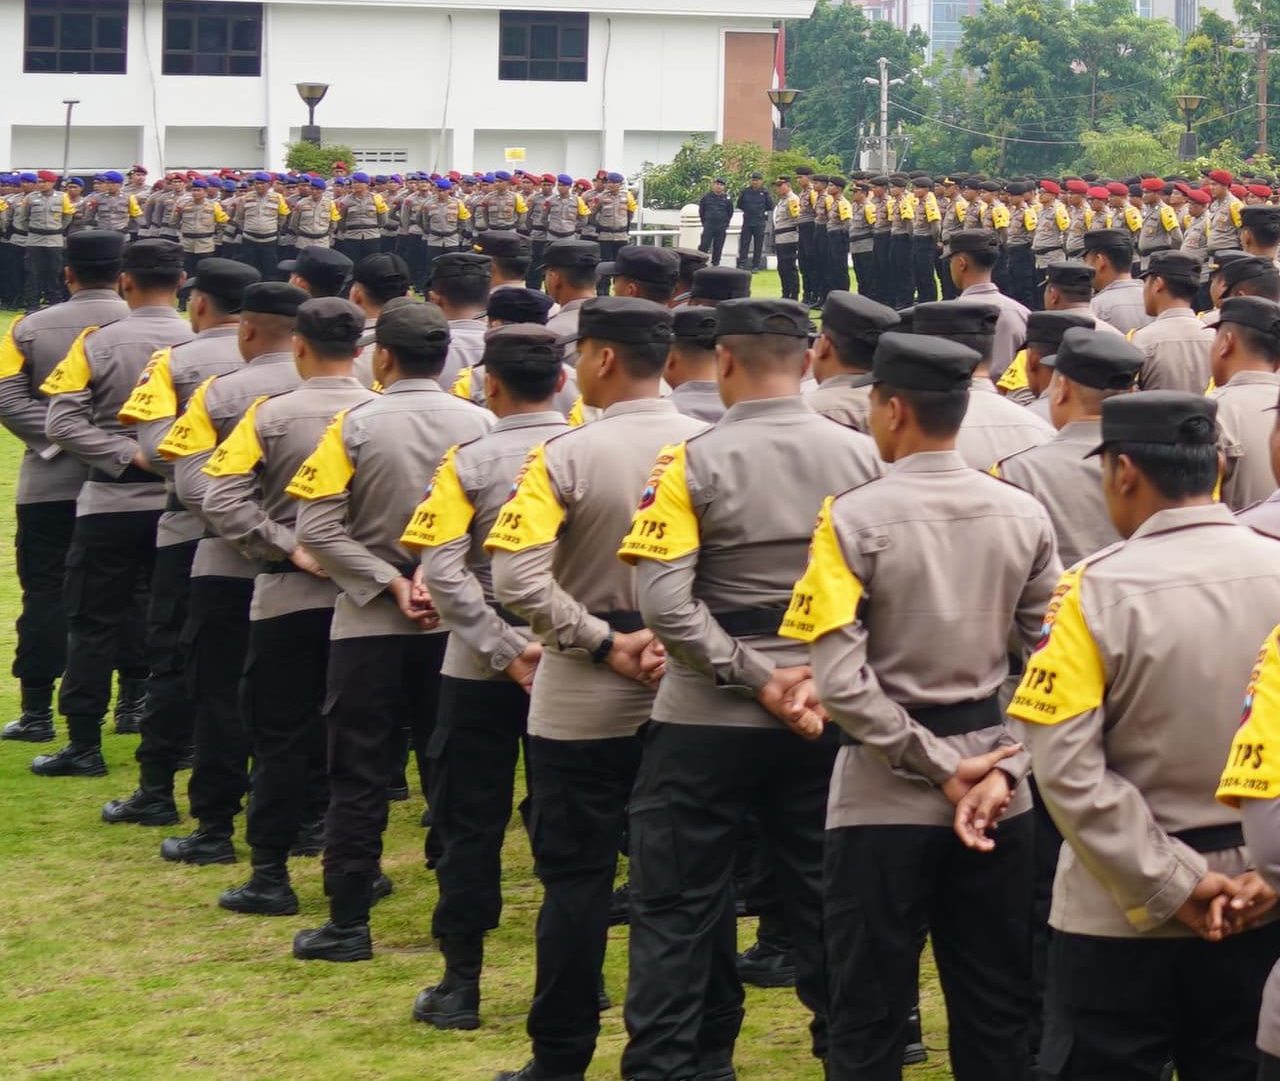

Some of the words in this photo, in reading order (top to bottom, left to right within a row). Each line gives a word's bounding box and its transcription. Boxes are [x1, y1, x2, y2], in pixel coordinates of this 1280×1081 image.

[134, 392, 153, 405] TPS
[174, 425, 190, 439] TPS
[413, 511, 436, 529] TPS
[498, 512, 522, 529] TPS
[640, 520, 667, 539] TPS
[1027, 668, 1056, 694] TPS
[1233, 743, 1264, 769] TPS
